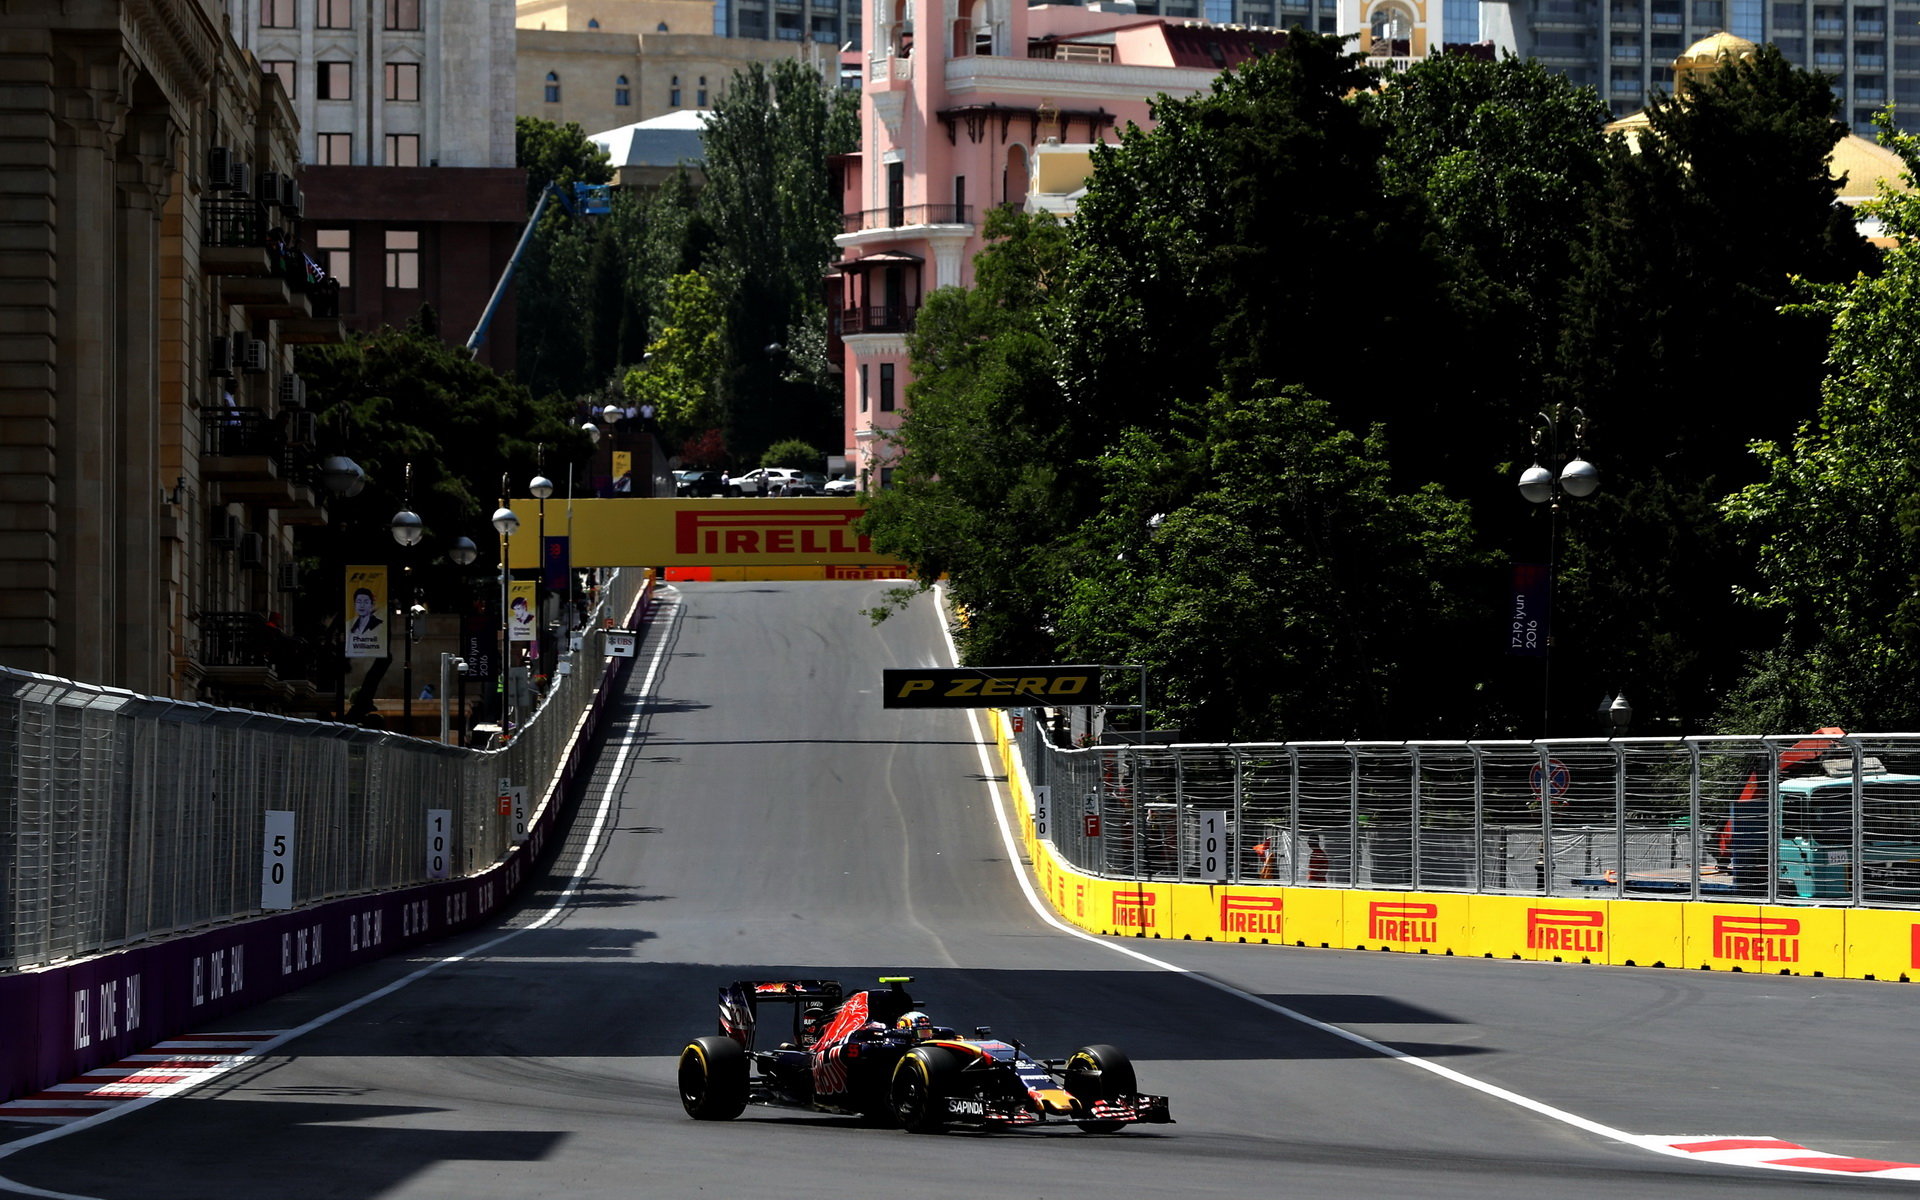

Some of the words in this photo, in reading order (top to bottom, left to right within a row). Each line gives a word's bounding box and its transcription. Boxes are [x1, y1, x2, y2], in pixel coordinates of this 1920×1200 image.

[1514, 595, 1526, 619] iyun
[1512, 622, 1523, 648] 17-19
[1526, 620, 1537, 648] 2016
[480, 655, 489, 676] 2016
[897, 680, 934, 698] P
[944, 676, 1088, 697] ZERO
[1013, 718, 1022, 729] F
[501, 799, 510, 813] F
[514, 792, 524, 834] 150
[433, 816, 444, 871] 100
[1087, 818, 1097, 834] F
[271, 835, 286, 884] 50
[1206, 818, 1217, 873] 100
[1112, 891, 1156, 928] PIRELLI
[1221, 895, 1283, 933] PIRELLI
[1369, 901, 1438, 943] PIRELLI
[1527, 908, 1604, 952] PIRELLI
[1713, 915, 1800, 963] PIRELLI
[74, 989, 90, 1051] WELL
[100, 980, 117, 1041] DONE
[948, 1100, 983, 1115] SAPINDA
